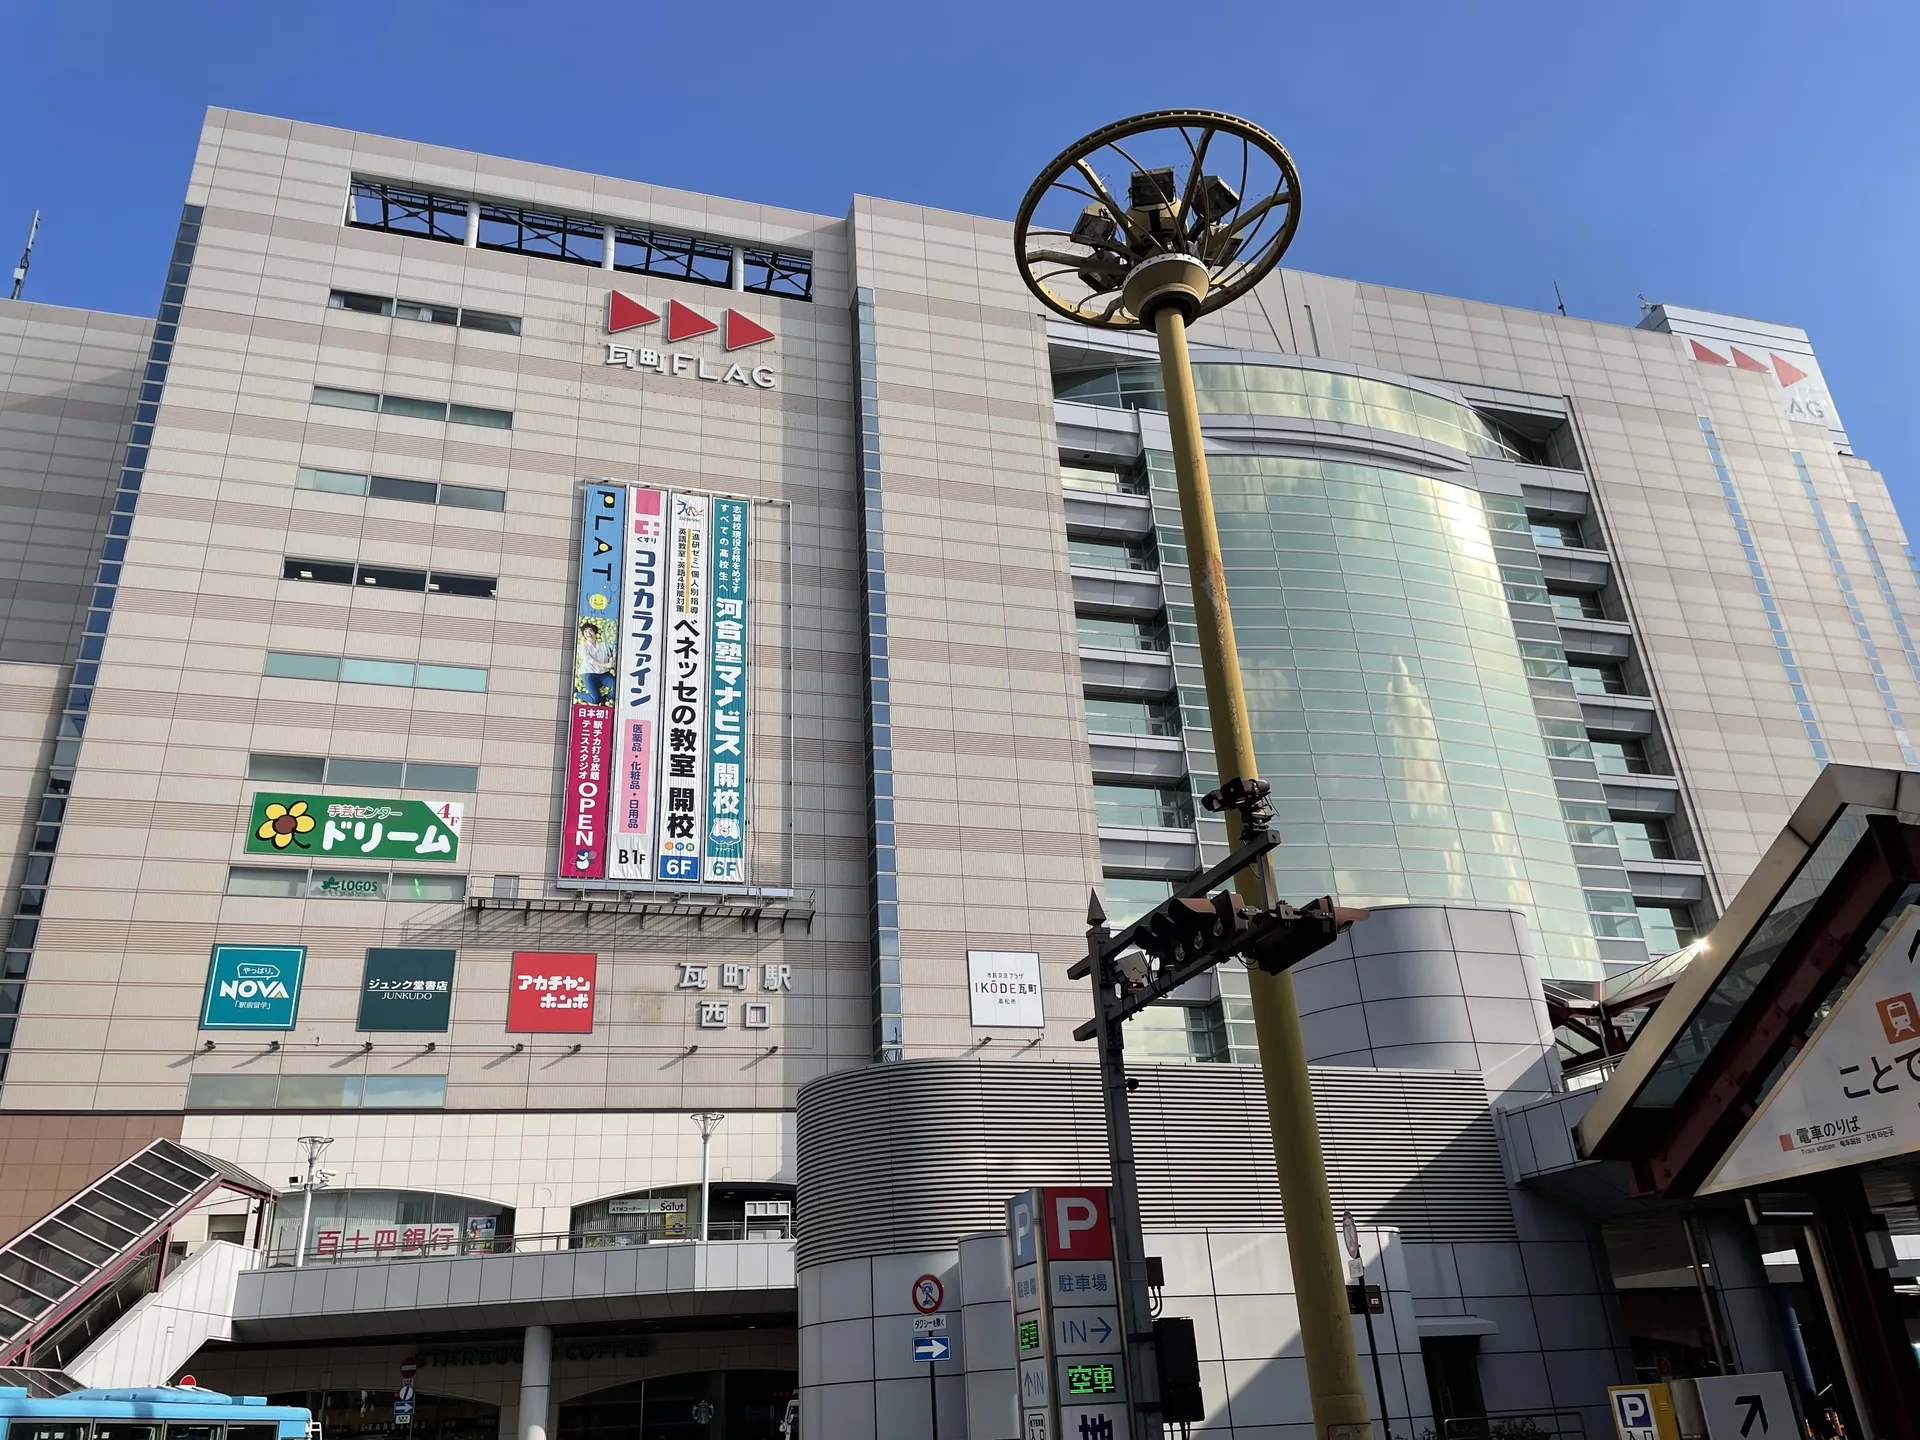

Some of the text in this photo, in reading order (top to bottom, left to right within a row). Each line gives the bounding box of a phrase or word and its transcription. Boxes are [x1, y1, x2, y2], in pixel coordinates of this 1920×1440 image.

[606, 343, 776, 388] 瓦町FLAG
[592, 490, 616, 582] PLAT
[636, 536, 657, 544] くすり
[718, 504, 730, 592] すべての高校生へ
[732, 505, 742, 593] 志望校現役合格をめざす
[630, 549, 656, 708] ココカラファイン
[578, 708, 609, 719] 日本初!
[712, 596, 744, 815] 河合塾マナビス 開校
[667, 619, 701, 840] ベネッセの教室 開校
[578, 720, 591, 780] テニススタジオ
[590, 720, 603, 781] 駅チカ打ち放題
[628, 724, 643, 829] 医薬品・化粧品・日用品
[327, 804, 403, 820] 手芸センター
[437, 803, 460, 827] 4F
[576, 782, 598, 847] OPEN
[322, 820, 451, 854] ドリーム
[666, 860, 692, 876] 6F
[712, 861, 737, 877] 6F
[340, 878, 378, 894] LOGOS
[368, 978, 448, 991] ジュンク堂書店
[517, 975, 591, 991] アカチャン
[679, 962, 793, 991] 瓦町駅
[219, 980, 290, 1001] NOVA
[381, 991, 433, 1001] JUNKUDO
[540, 993, 589, 1009] ホンポ
[700, 1000, 771, 1029] 西口
[1796, 1115, 1862, 1144] 電車のりば
[1800, 1143, 1836, 1155] Train station
[660, 1202, 684, 1211] Salut
[1013, 1202, 1030, 1256] P
[1056, 1197, 1098, 1249] P
[317, 1227, 455, 1254] 百十四銀行
[1017, 1277, 1037, 1299] 駐車場
[1058, 1273, 1108, 1293] 駐車場
[915, 1317, 945, 1329] タクシーを除く
[1062, 1320, 1087, 1344] IN
[416, 1341, 651, 1368] STARBUC COFFEE
[1032, 1371, 1045, 1395] IN
[1068, 1364, 1115, 1394] 空車
[1621, 1396, 1646, 1426] P
